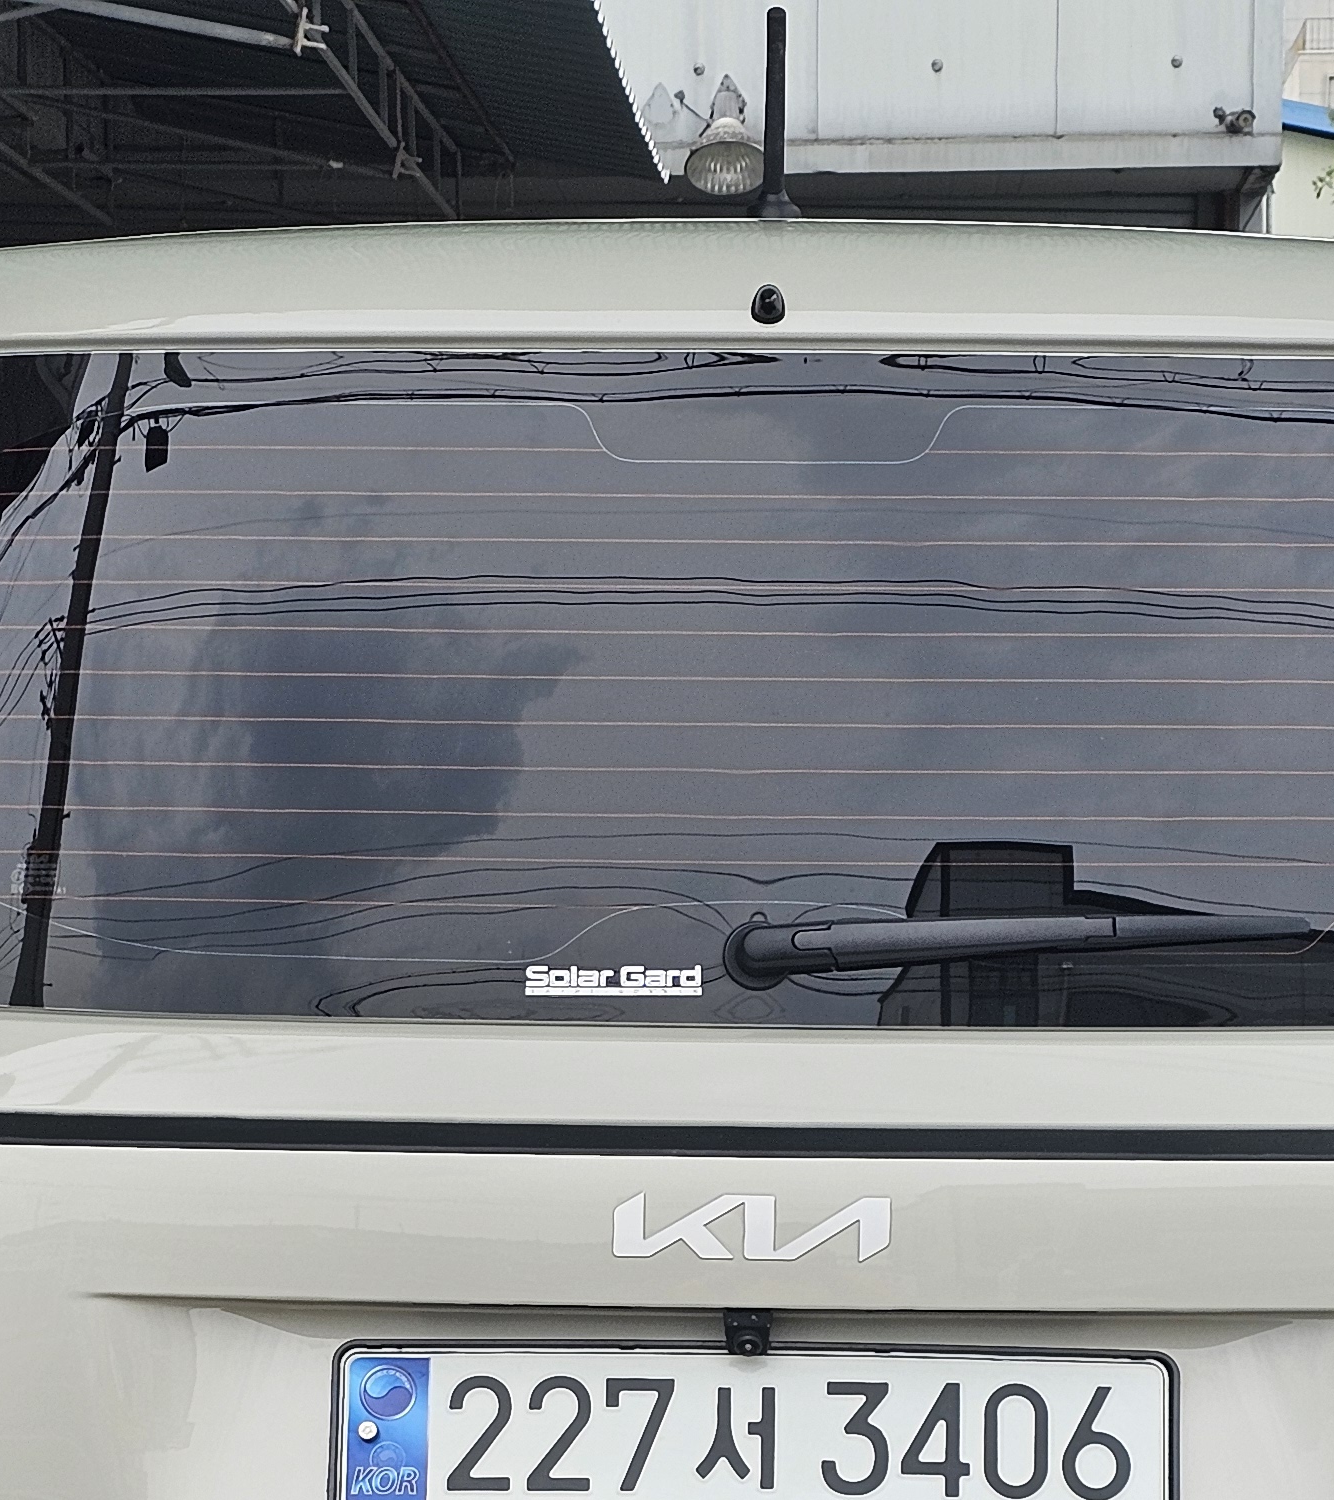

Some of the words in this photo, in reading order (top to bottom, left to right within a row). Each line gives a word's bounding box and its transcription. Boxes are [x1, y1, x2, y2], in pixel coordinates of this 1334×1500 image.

[525, 965, 616, 987] Solar
[620, 964, 703, 987] Gard
[612, 1191, 892, 1263] KIA
[350, 1466, 420, 1496] KOR
